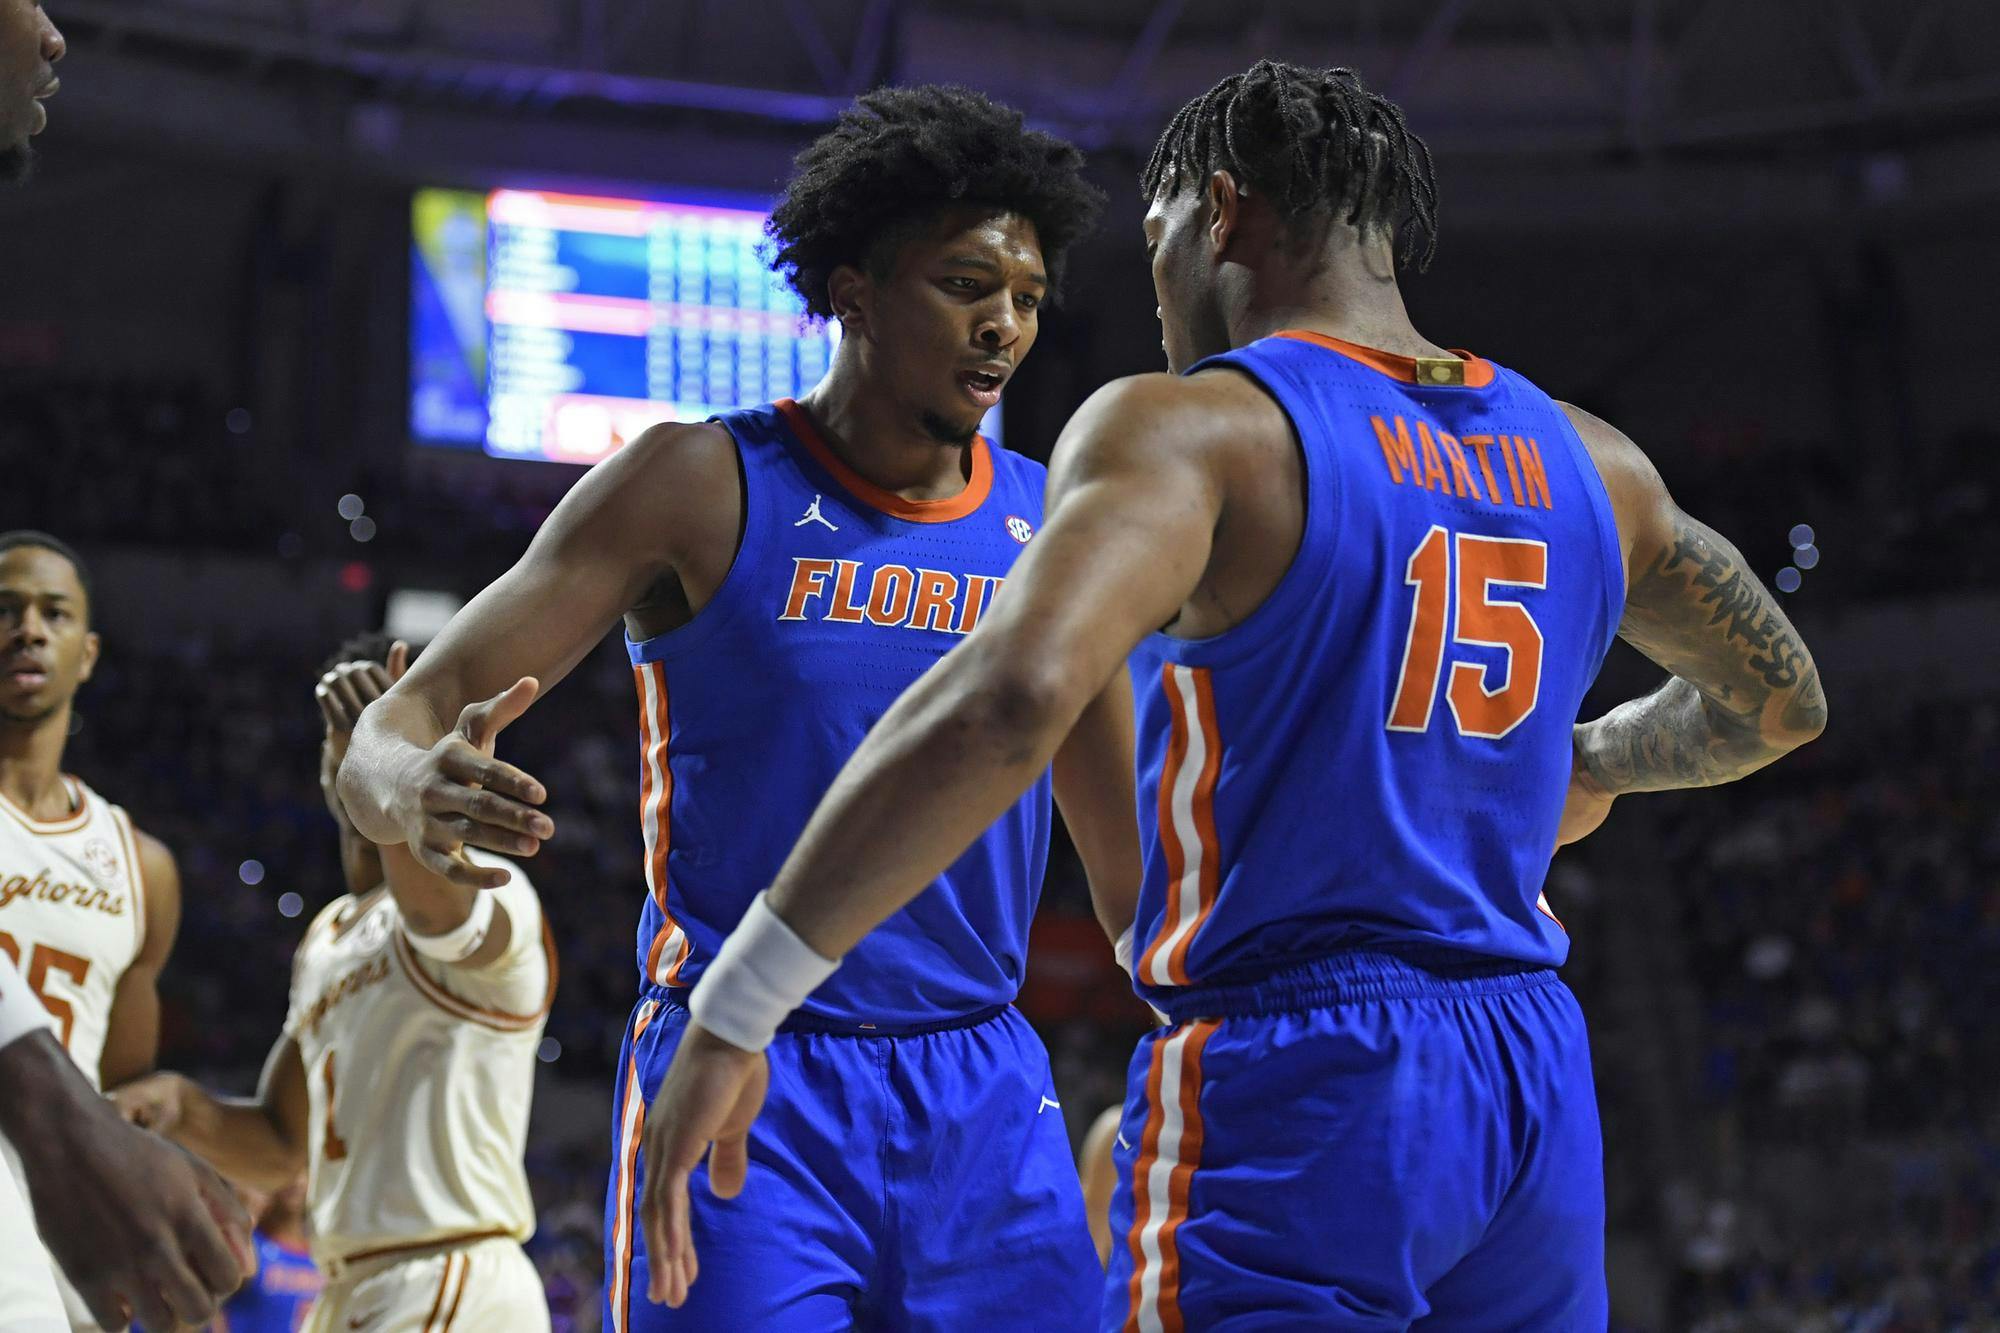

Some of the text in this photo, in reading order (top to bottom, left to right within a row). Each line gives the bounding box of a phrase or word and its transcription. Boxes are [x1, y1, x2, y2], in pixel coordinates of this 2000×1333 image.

[1370, 415, 1552, 509] MARTIN
[1008, 517, 1033, 543] SEC
[777, 557, 1006, 634] FLORI
[1385, 524, 1548, 739] 15
[1664, 526, 1805, 688] FEARLESS
[0, 867, 124, 916] ghorns
